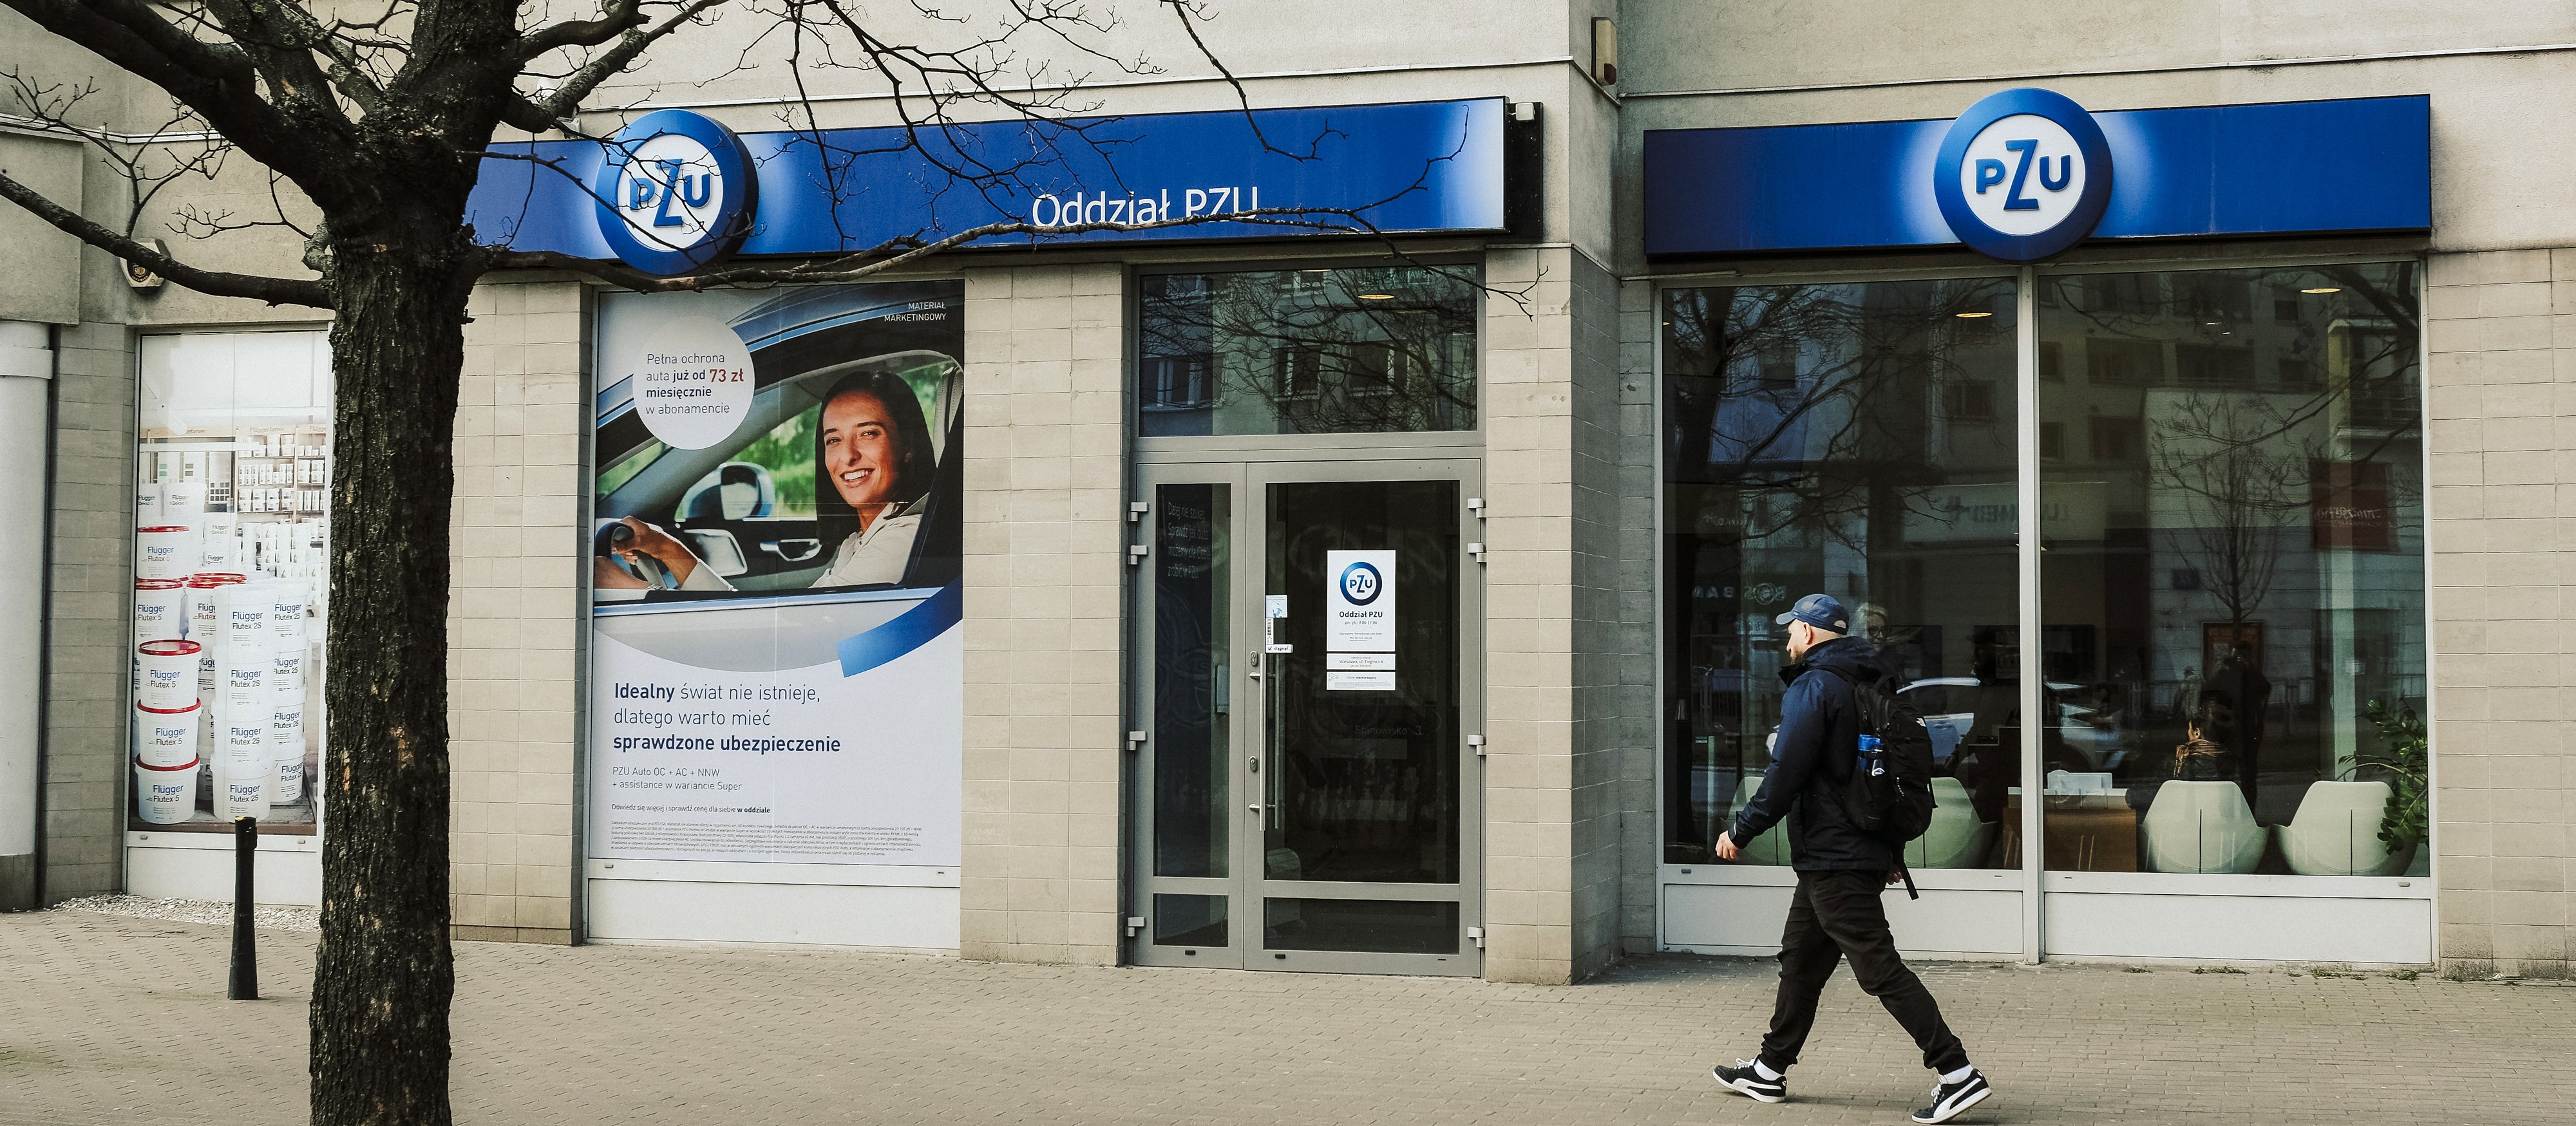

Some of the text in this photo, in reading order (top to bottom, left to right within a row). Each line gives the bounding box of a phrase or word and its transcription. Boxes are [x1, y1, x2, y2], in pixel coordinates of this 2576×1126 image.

[1975, 138, 2071, 212] PZU
[629, 158, 712, 227] PZU
[1032, 185, 1258, 227] Oddział PZU
[908, 301, 947, 310] MATERIAŁ
[884, 313, 947, 322] MARKETINGOWY
[647, 353, 725, 364] Pełna ochrona
[646, 368, 744, 383] auta już od 73 zł
[646, 386, 712, 400] miesięcznie
[645, 402, 730, 415] w abonamencie
[1349, 574, 1373, 593] PZU
[137, 604, 166, 614] Flügger
[274, 603, 302, 613] Flügger
[232, 611, 264, 622] Flügger
[150, 670, 180, 680] Flügger
[231, 669, 262, 680] Flügger
[171, 680, 176, 688] 5
[614, 683, 821, 705] Idealny świat nie istnieje,
[274, 711, 301, 722] Flügger
[614, 708, 771, 729] dlatego warto mieć
[156, 727, 186, 738] Flügger
[231, 727, 262, 738] Flügger
[612, 734, 841, 755] sprawdzone ubezpieczenie
[612, 766, 630, 776] PZU
[632, 767, 651, 776] Auto
[654, 767, 666, 776] OC
[675, 767, 688, 777] AC
[697, 768, 720, 777] NNW
[153, 784, 184, 796] Flügger
[230, 784, 261, 796] Flügger
[619, 780, 663, 789] assistance
[675, 781, 715, 791] wariancie
[717, 781, 743, 793] Super
[668, 805, 693, 813] sprawdź
